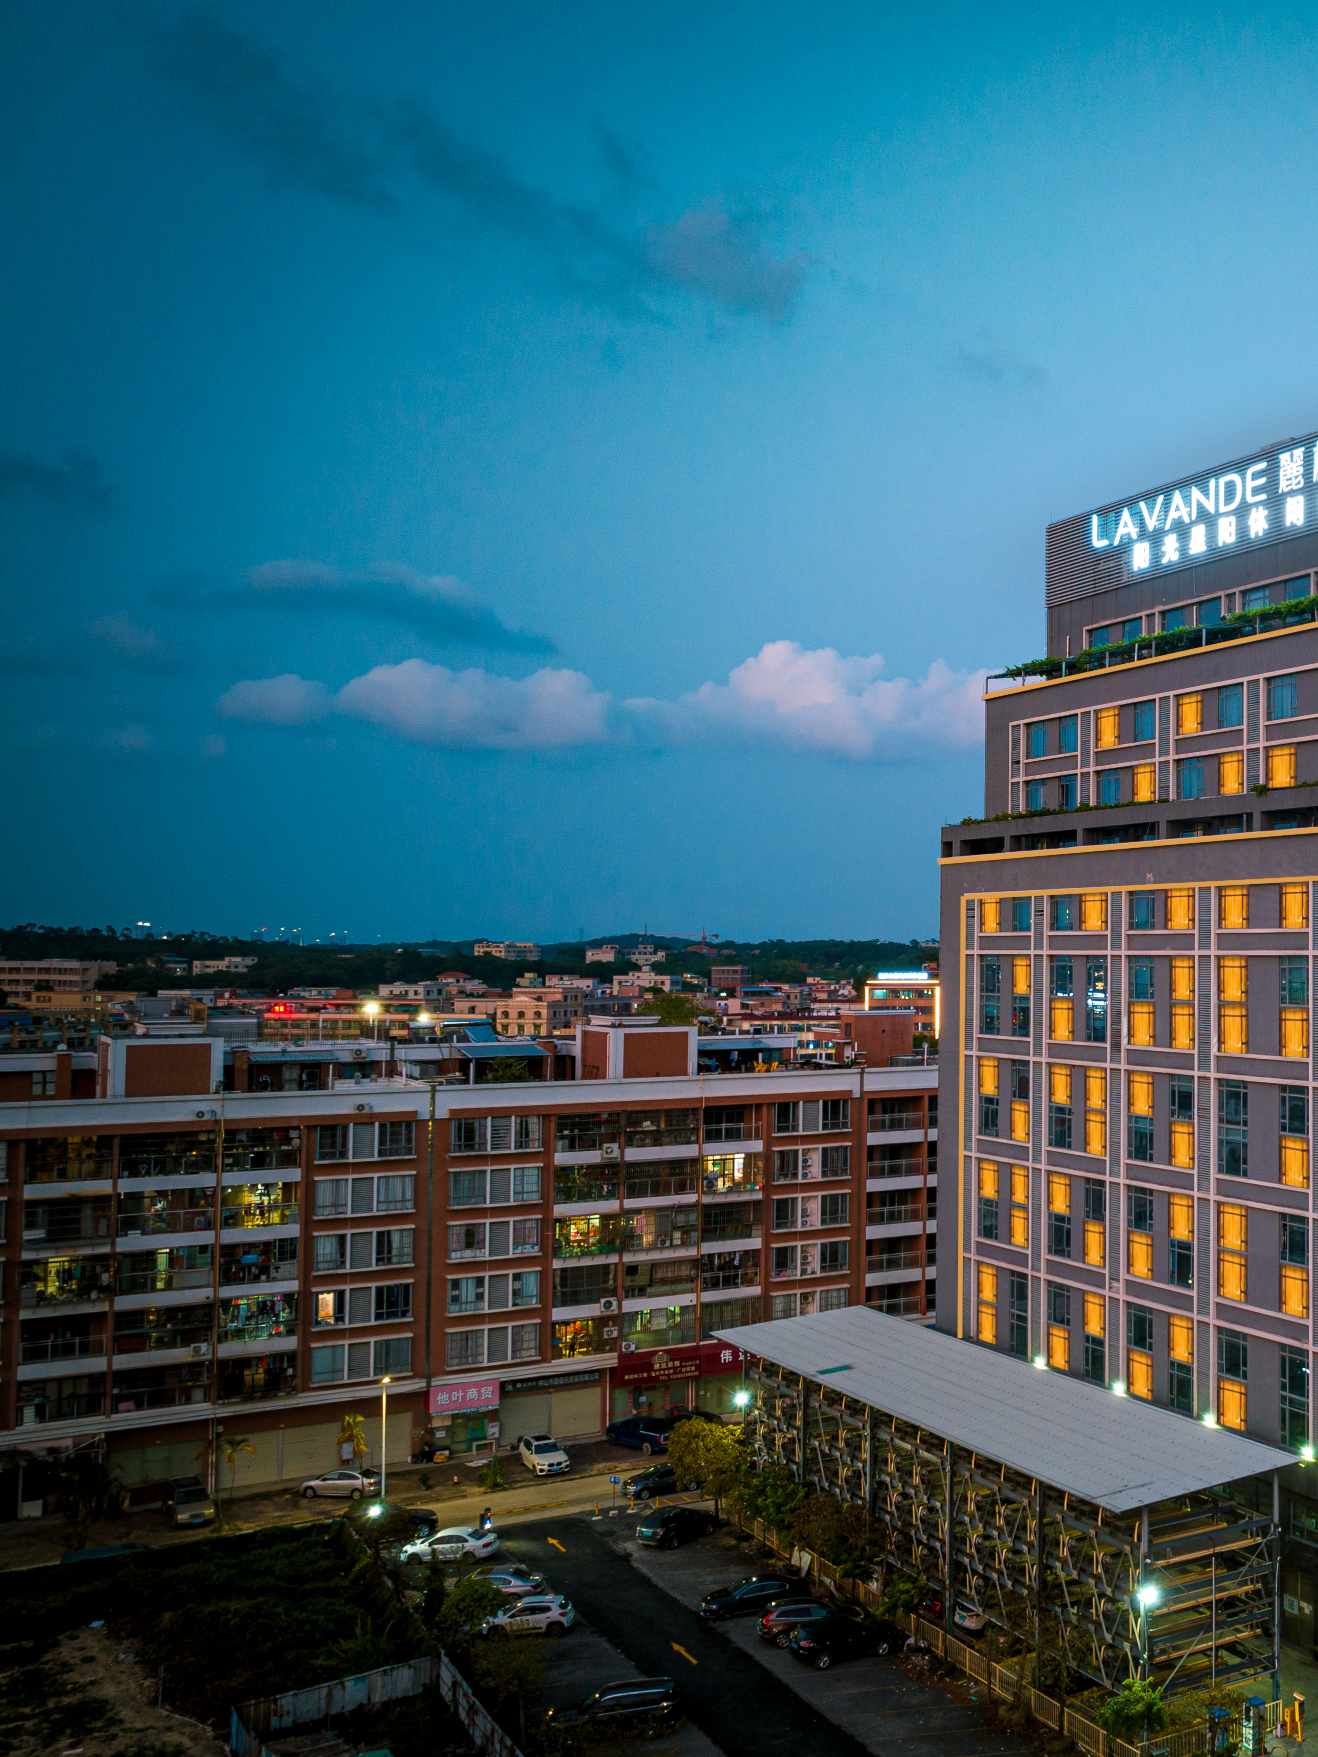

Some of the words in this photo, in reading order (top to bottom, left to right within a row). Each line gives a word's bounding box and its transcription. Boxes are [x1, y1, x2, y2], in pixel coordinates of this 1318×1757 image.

[1092, 461, 1268, 547] LAVANDE
[436, 1386, 493, 1405] 他叶商贸
